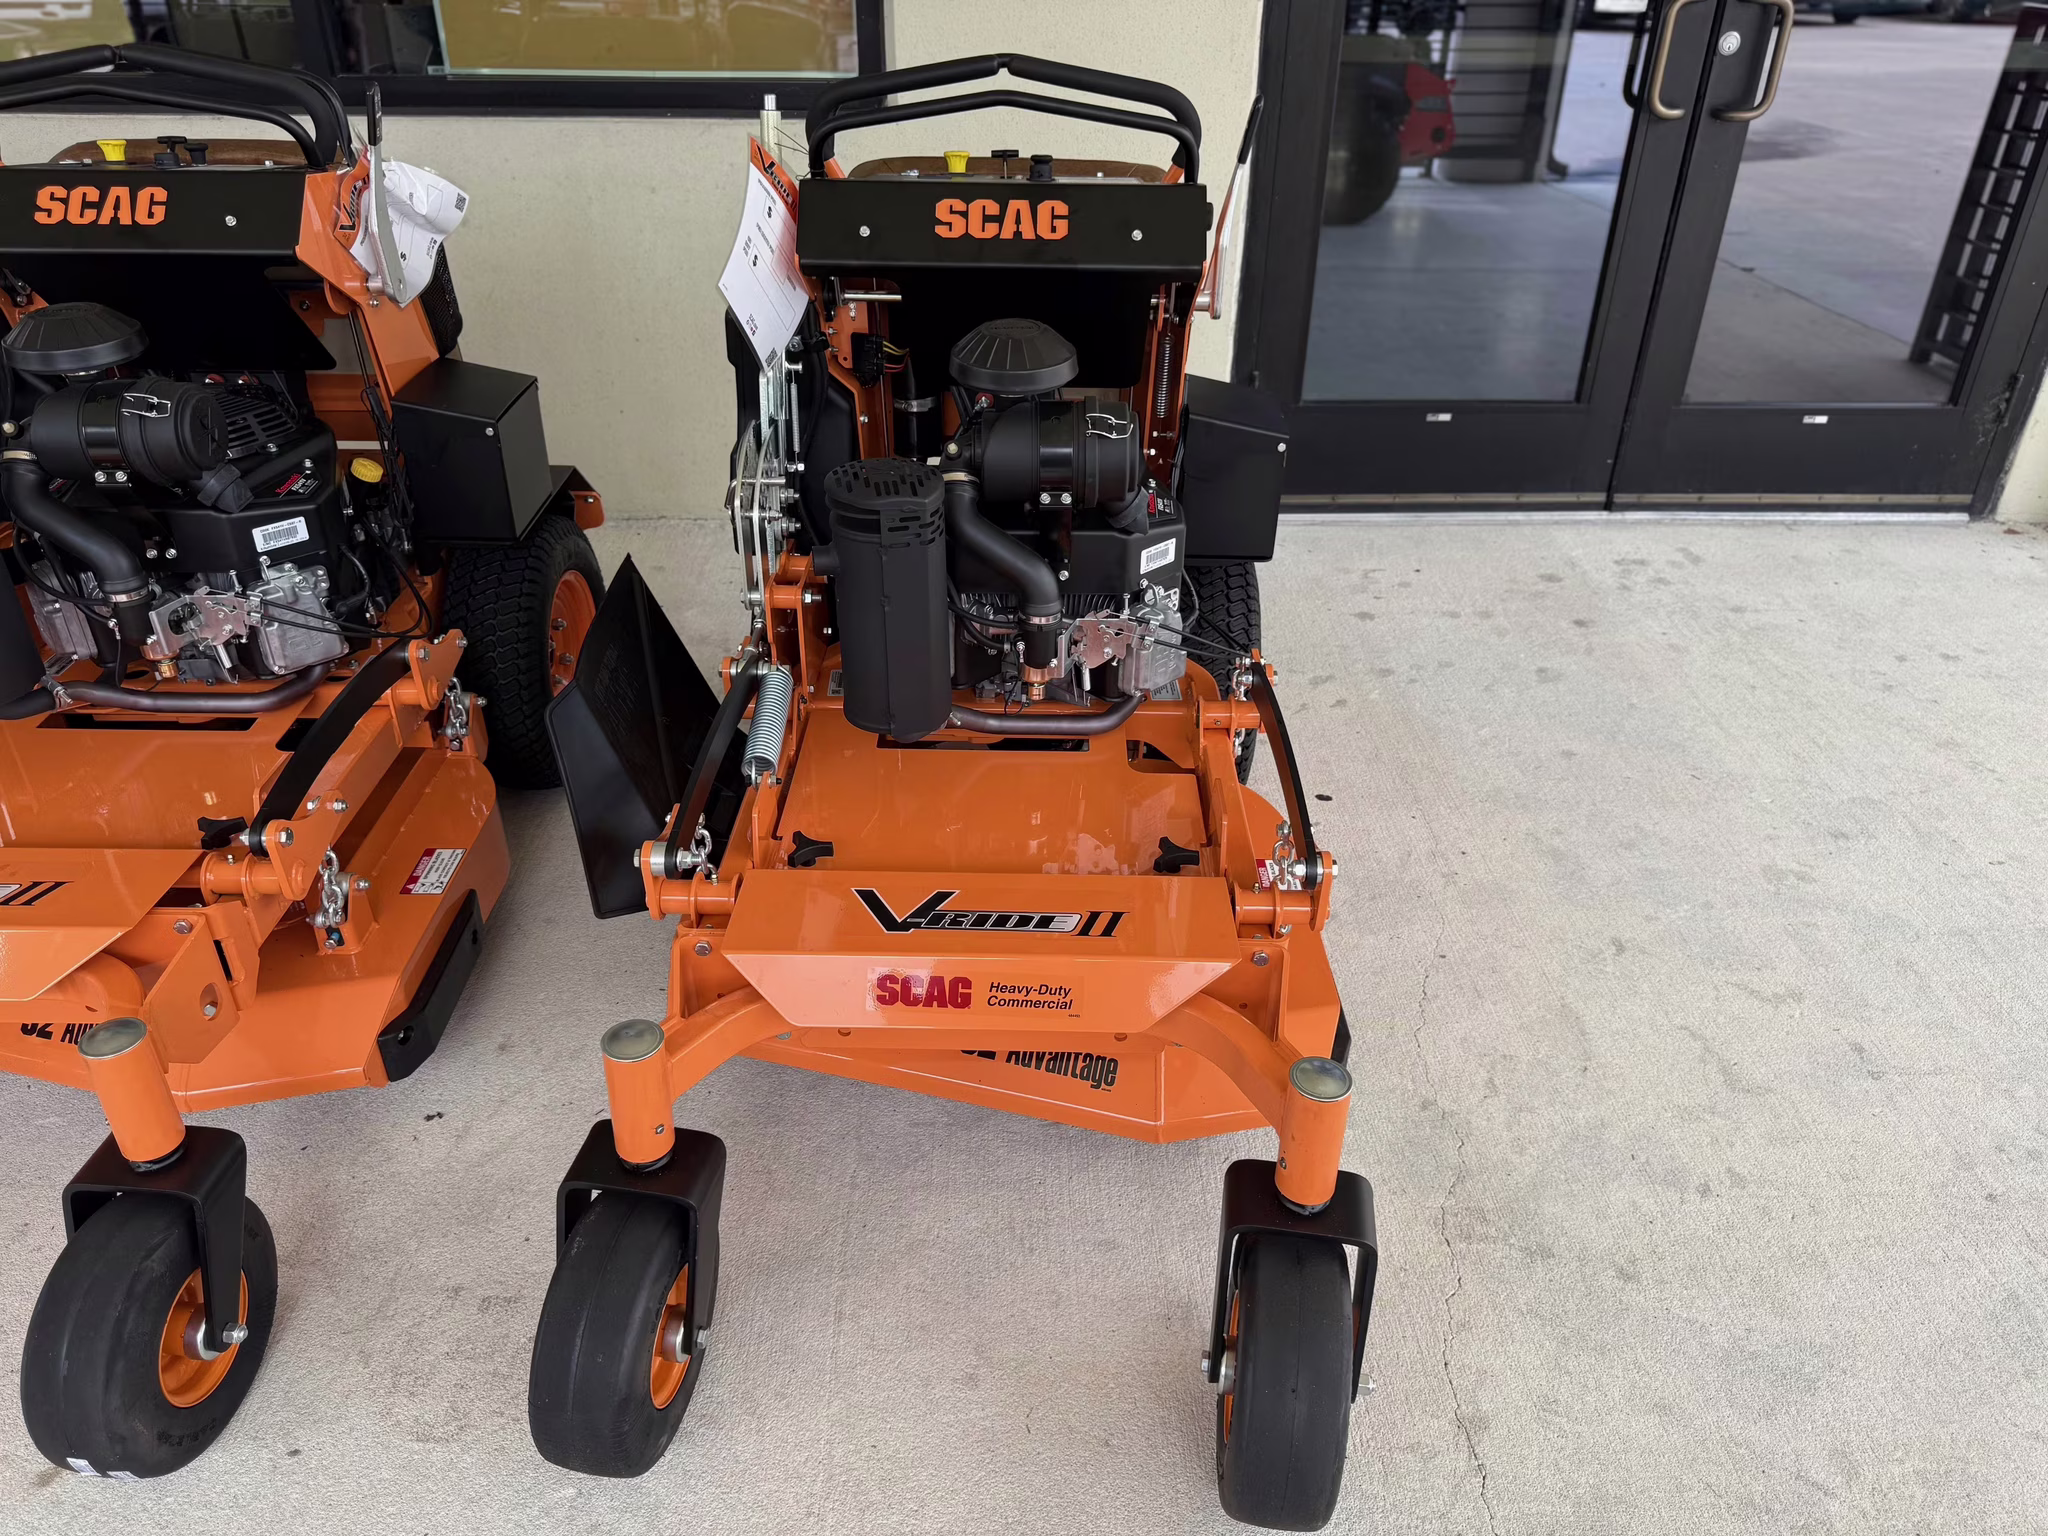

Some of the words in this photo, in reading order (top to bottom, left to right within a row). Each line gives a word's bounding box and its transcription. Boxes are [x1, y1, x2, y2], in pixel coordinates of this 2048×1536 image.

[34, 185, 168, 226] SCAG
[934, 198, 1069, 240] SCAG
[412, 856, 432, 877] DANGER
[875, 973, 973, 1010] SCAG
[986, 995, 1074, 1011] Commercial
[988, 981, 1073, 998] Heavy-Duty
